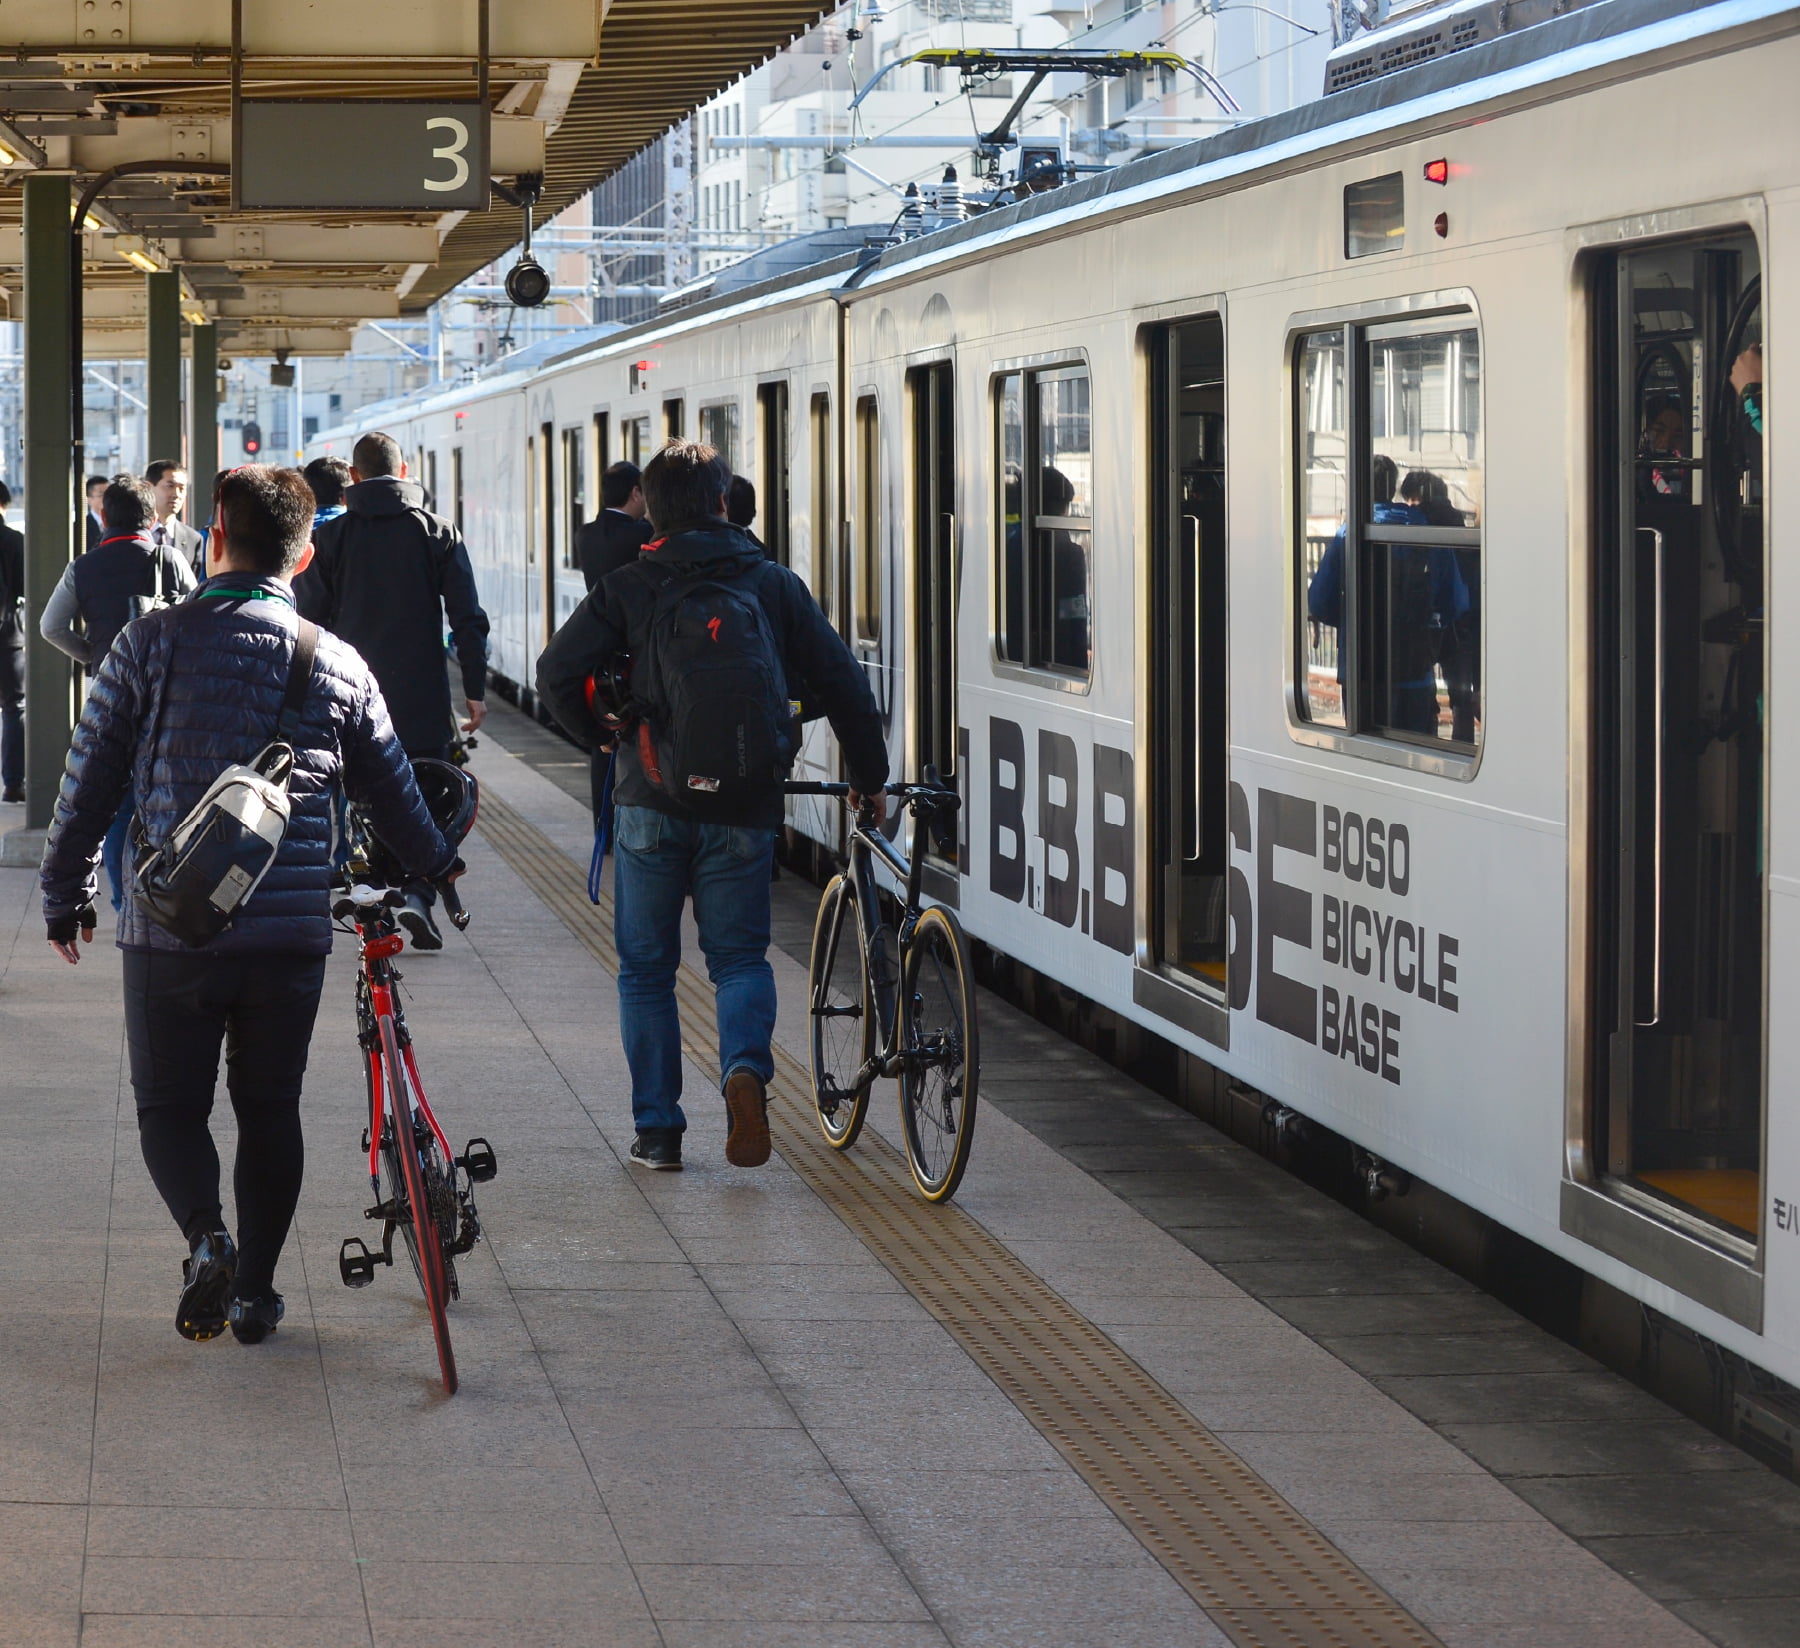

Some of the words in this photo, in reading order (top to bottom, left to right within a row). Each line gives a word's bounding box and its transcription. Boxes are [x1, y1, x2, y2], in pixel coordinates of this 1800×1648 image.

[424, 117, 469, 191] 3
[1323, 804, 1410, 896] BOSO
[1323, 893, 1459, 1013] BICYCLE
[1322, 984, 1401, 1086] BASE
